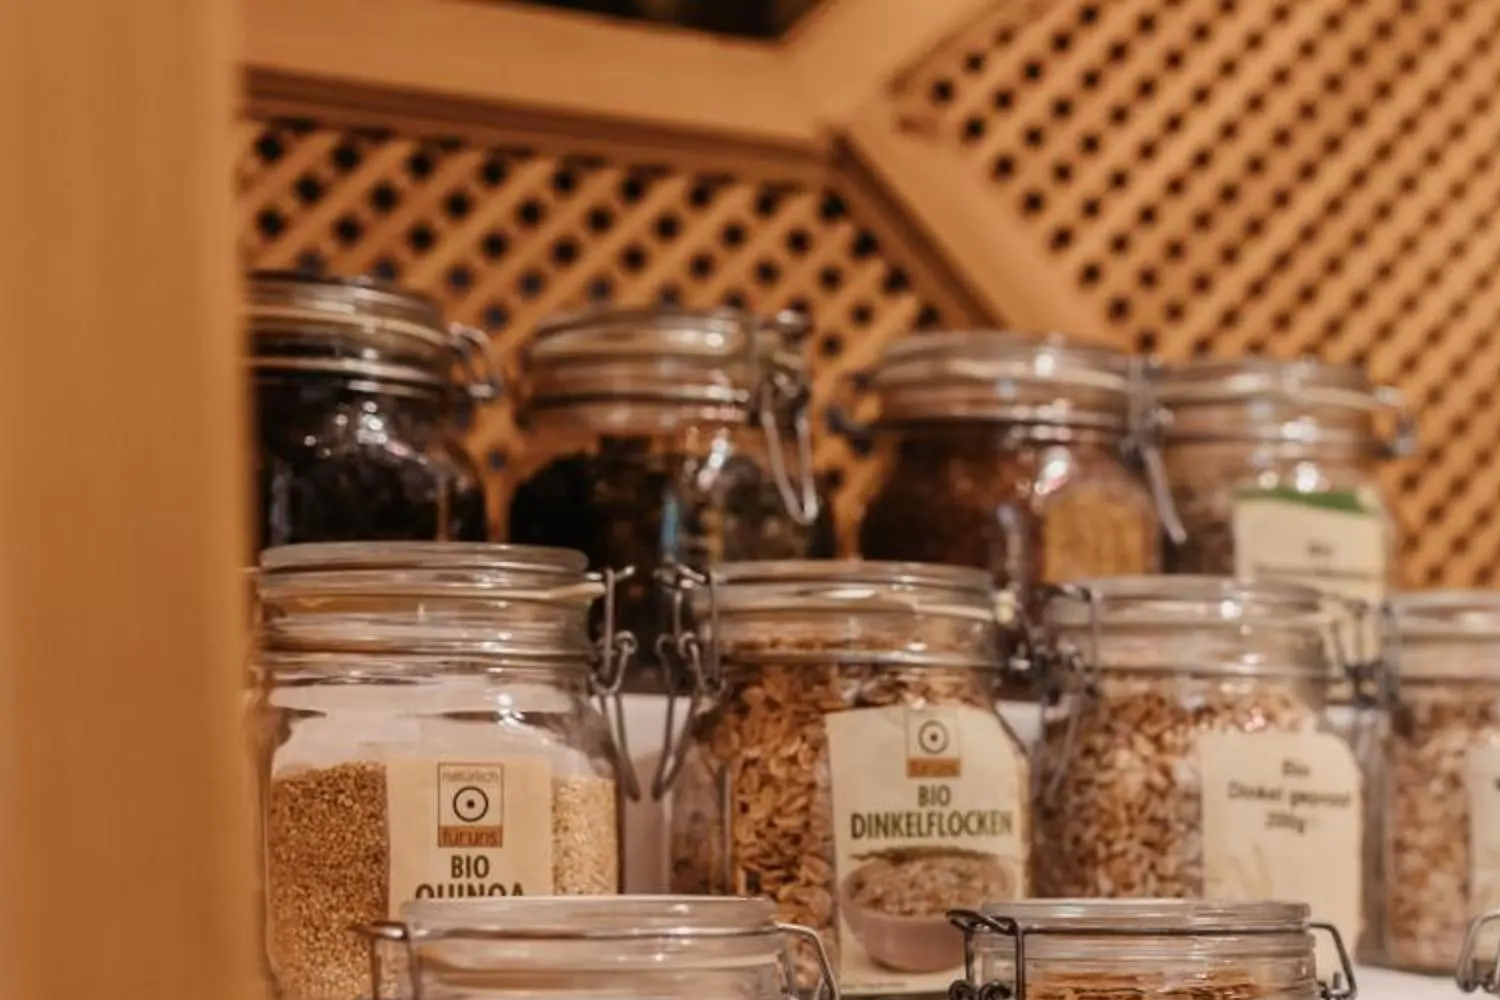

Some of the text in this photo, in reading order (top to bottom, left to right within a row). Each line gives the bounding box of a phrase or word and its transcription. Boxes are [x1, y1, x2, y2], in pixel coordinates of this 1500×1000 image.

[920, 784, 951, 807] BIO
[850, 810, 1013, 839] DINKELFLOCKEN
[450, 854, 490, 879] BIO
